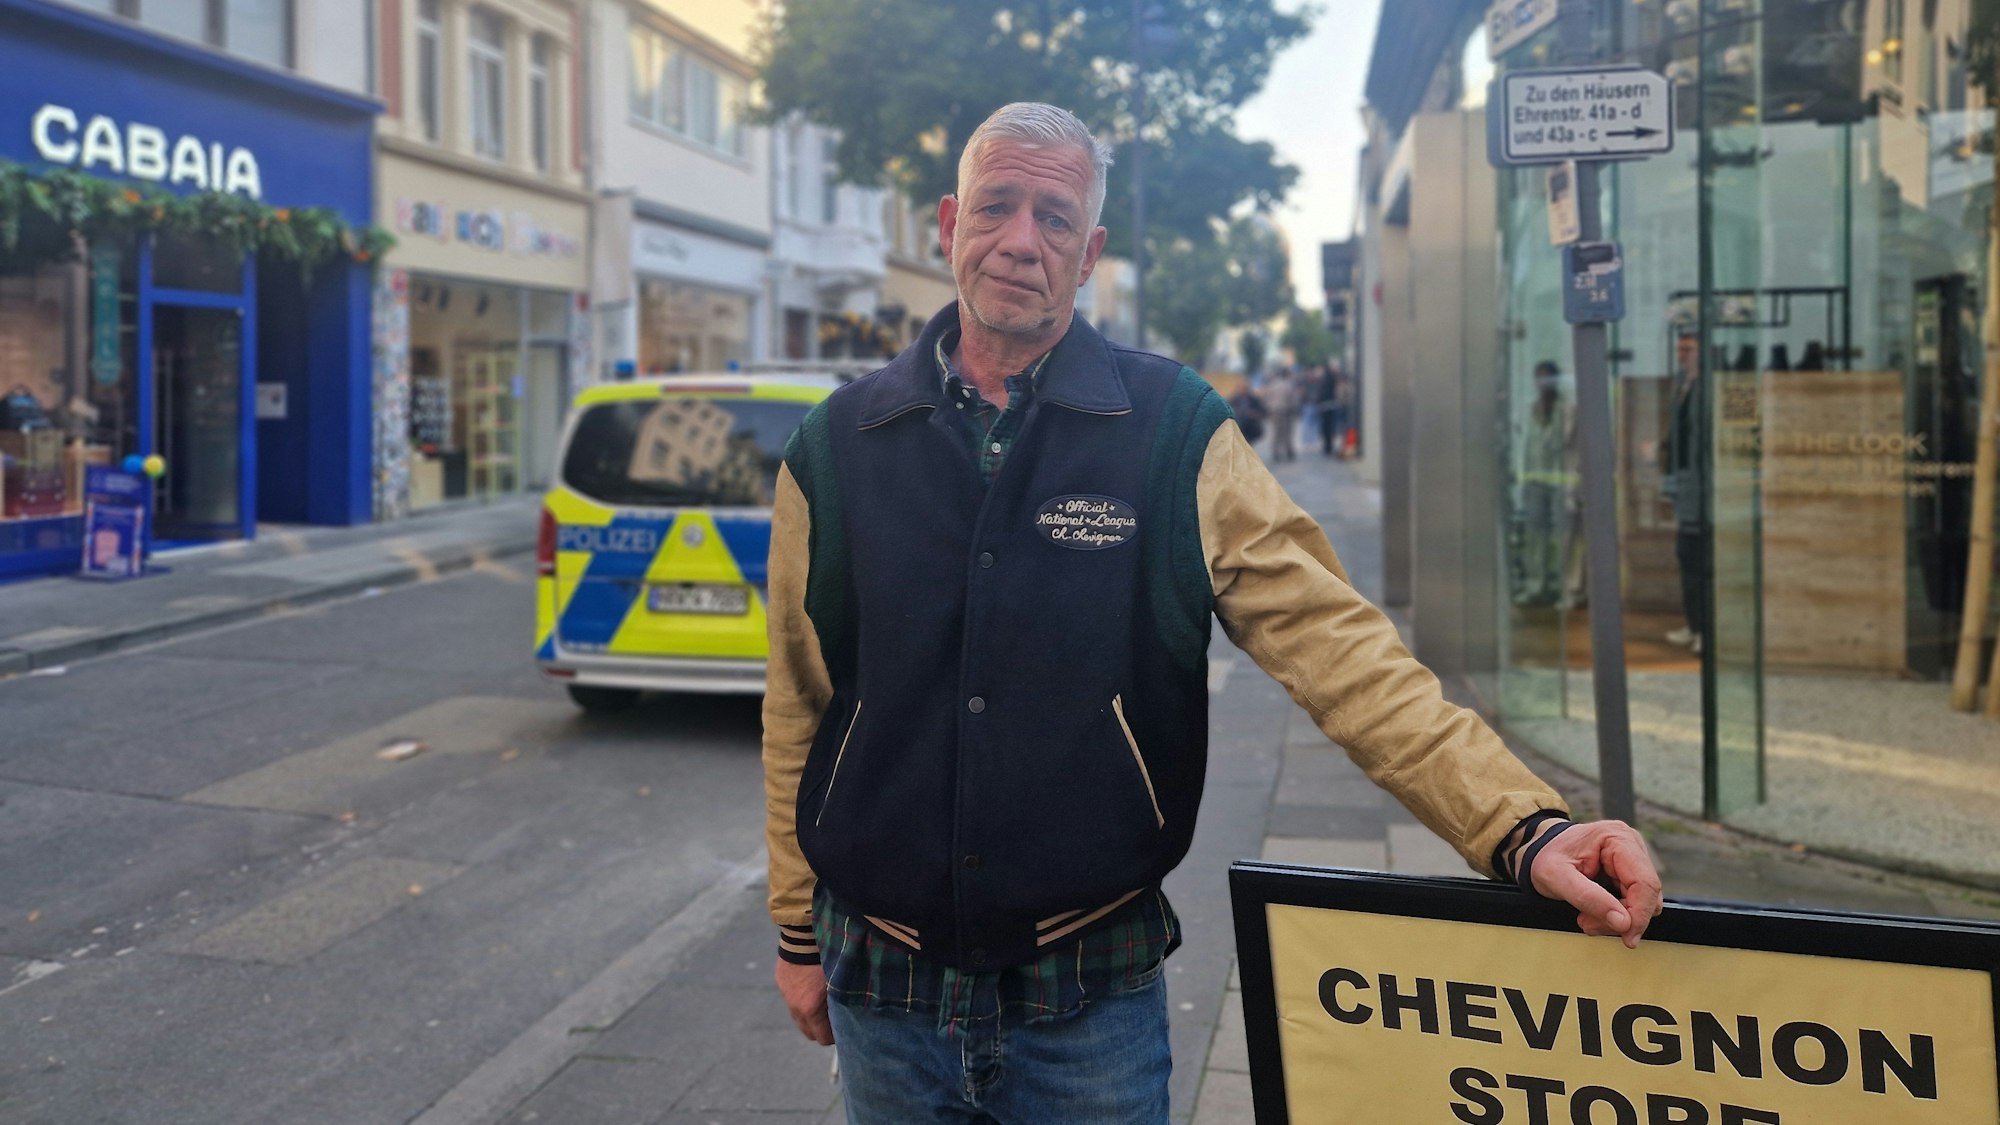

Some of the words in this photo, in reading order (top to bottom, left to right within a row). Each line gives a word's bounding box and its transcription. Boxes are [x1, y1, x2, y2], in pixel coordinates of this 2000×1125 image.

[1526, 85, 1546, 103] Zu
[1551, 85, 1580, 101] den
[1584, 83, 1650, 100] Häusern
[1514, 105, 1585, 124] Ehrenstr.
[1588, 104, 1616, 121] 41a
[1631, 103, 1641, 119] d
[1514, 127, 1543, 144] und
[1548, 126, 1574, 143] 43a
[1589, 129, 1598, 142] c
[33, 103, 262, 199] CABAIA
[1847, 432, 1928, 455] LOOK
[1065, 500, 1108, 513] Official
[1036, 513, 1084, 526] National
[1090, 513, 1136, 529] League
[558, 526, 657, 551] POLIZEI
[1318, 967, 1938, 1100] CHEVIGNON
